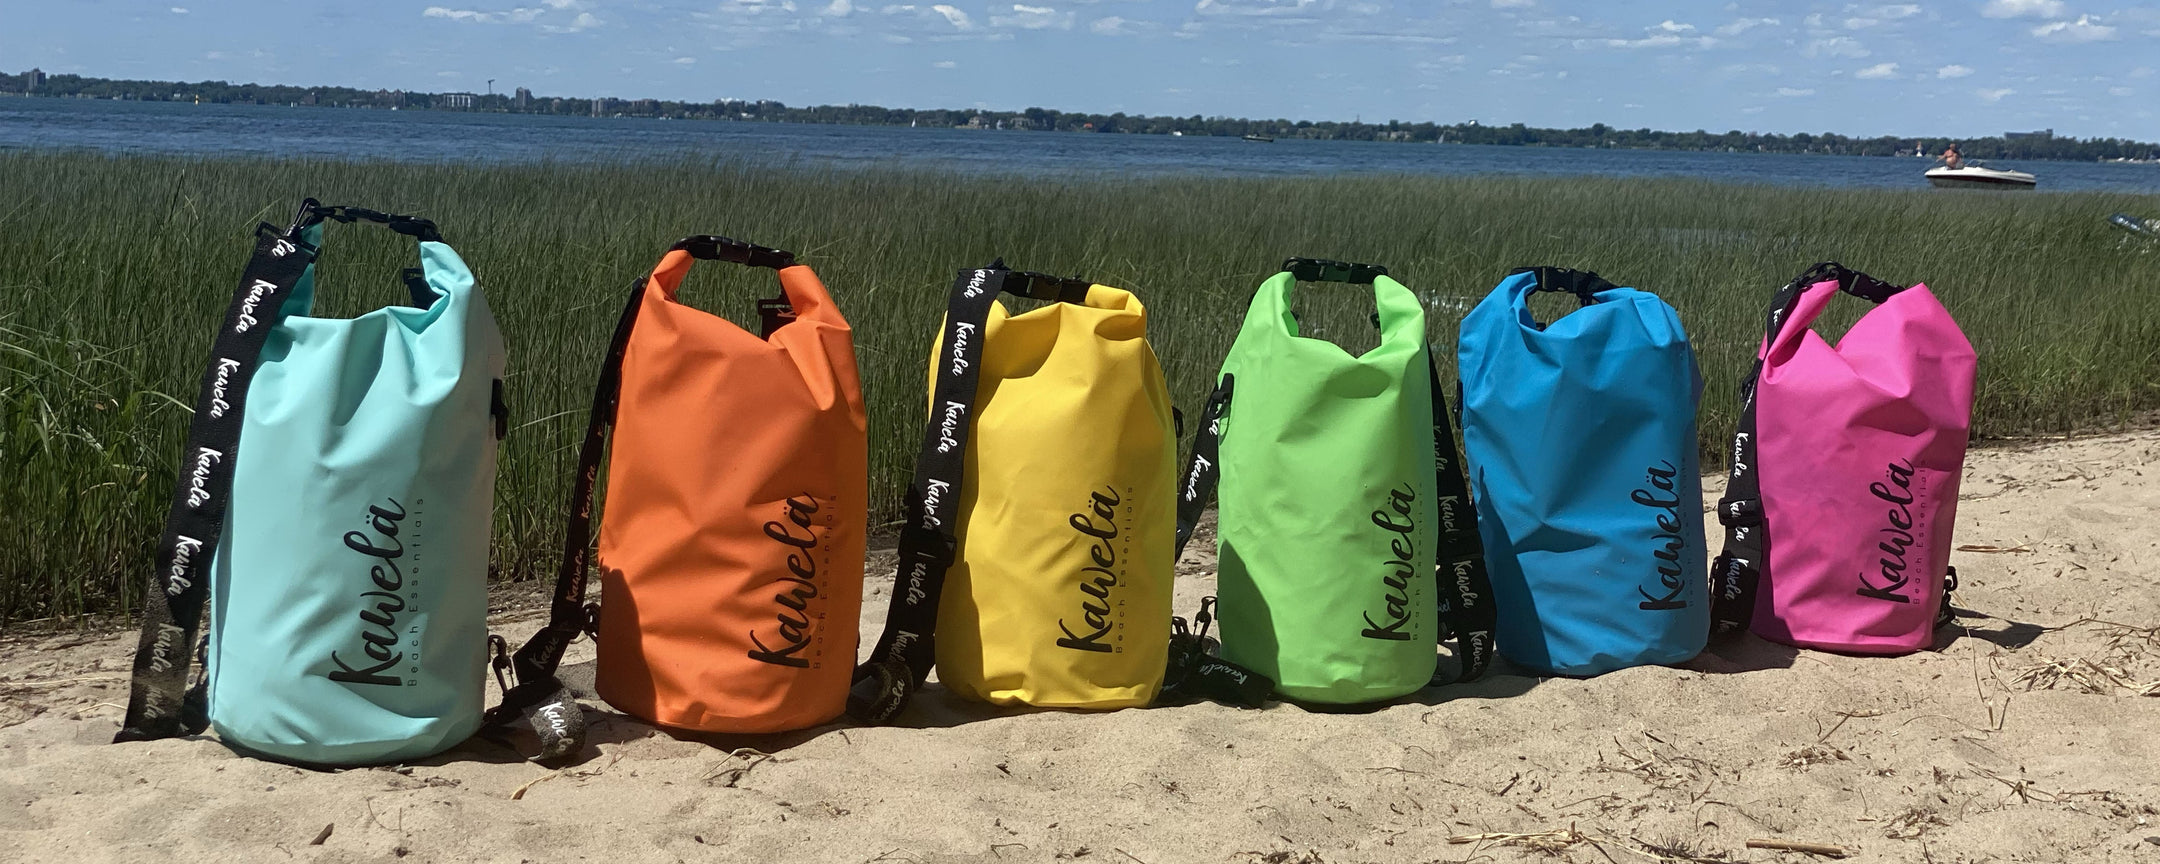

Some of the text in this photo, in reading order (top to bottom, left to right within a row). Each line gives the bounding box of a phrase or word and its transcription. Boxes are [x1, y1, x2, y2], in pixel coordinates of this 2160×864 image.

[407, 498, 424, 687] Beach Essentials
[1116, 599, 1125, 654] Beach
